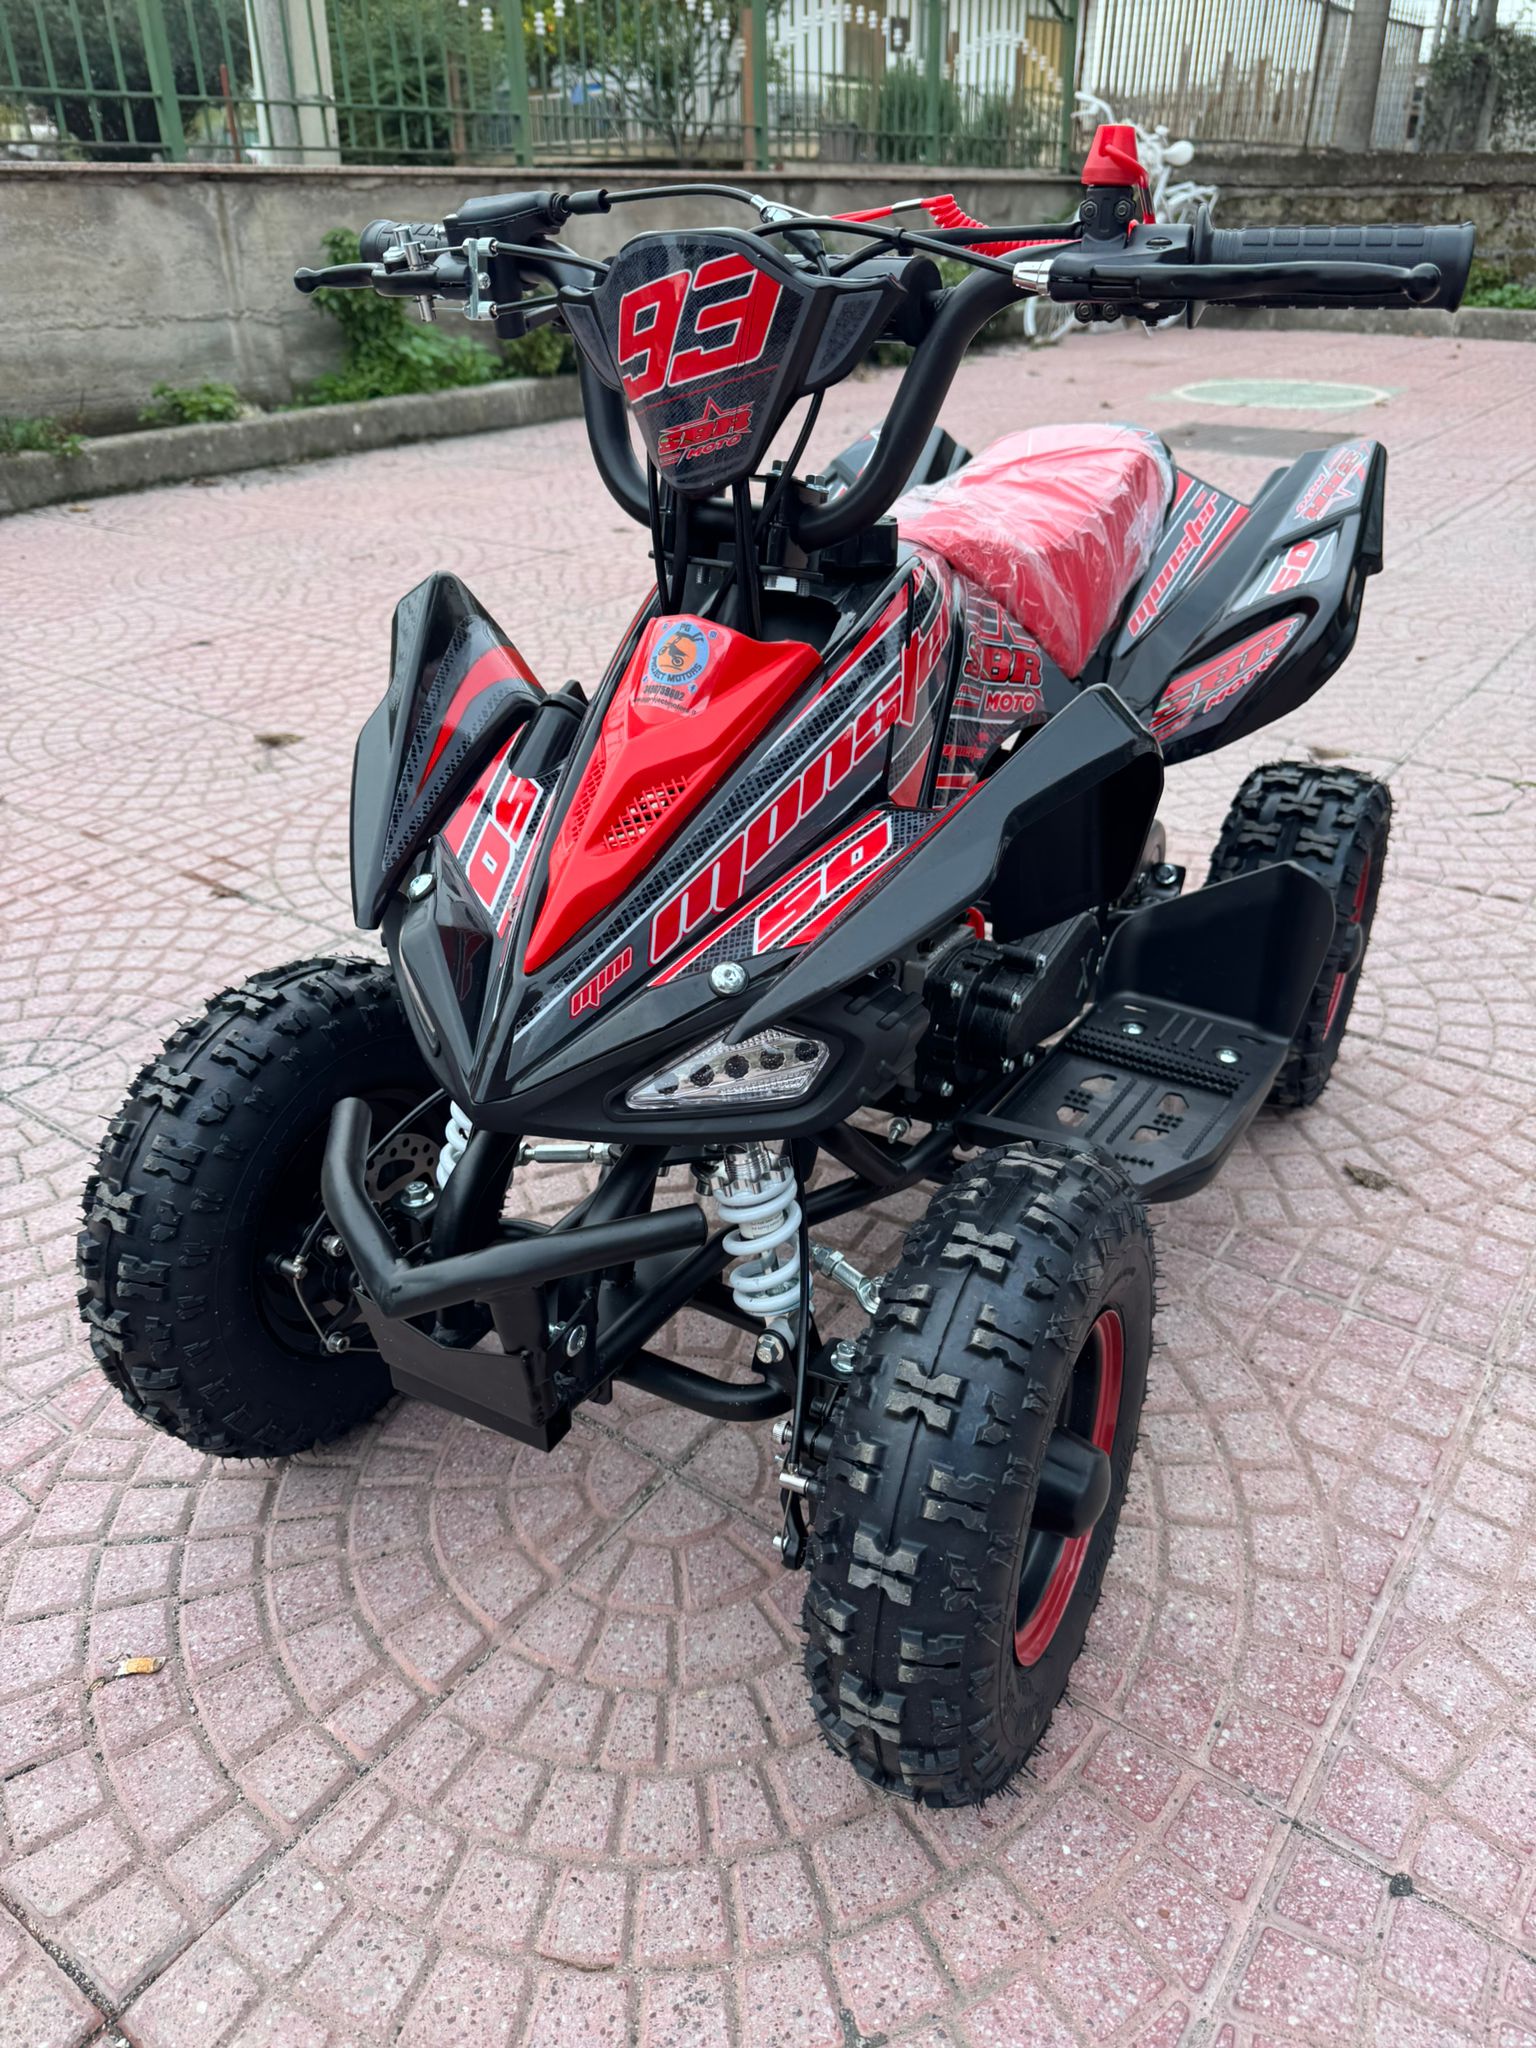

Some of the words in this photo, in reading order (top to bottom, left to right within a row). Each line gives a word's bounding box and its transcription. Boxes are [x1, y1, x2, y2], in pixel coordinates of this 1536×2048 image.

[617, 252, 783, 404] 93
[658, 409, 754, 456] SBR
[686, 433, 742, 460] MOTO
[1127, 491, 1219, 636] monster
[1265, 539, 1320, 595] 50
[666, 662, 703, 682] MOTORS
[962, 632, 1043, 689] SBR
[1203, 652, 1279, 713] MOTO
[984, 690, 1035, 714] MOTO
[751, 815, 893, 956] 50
